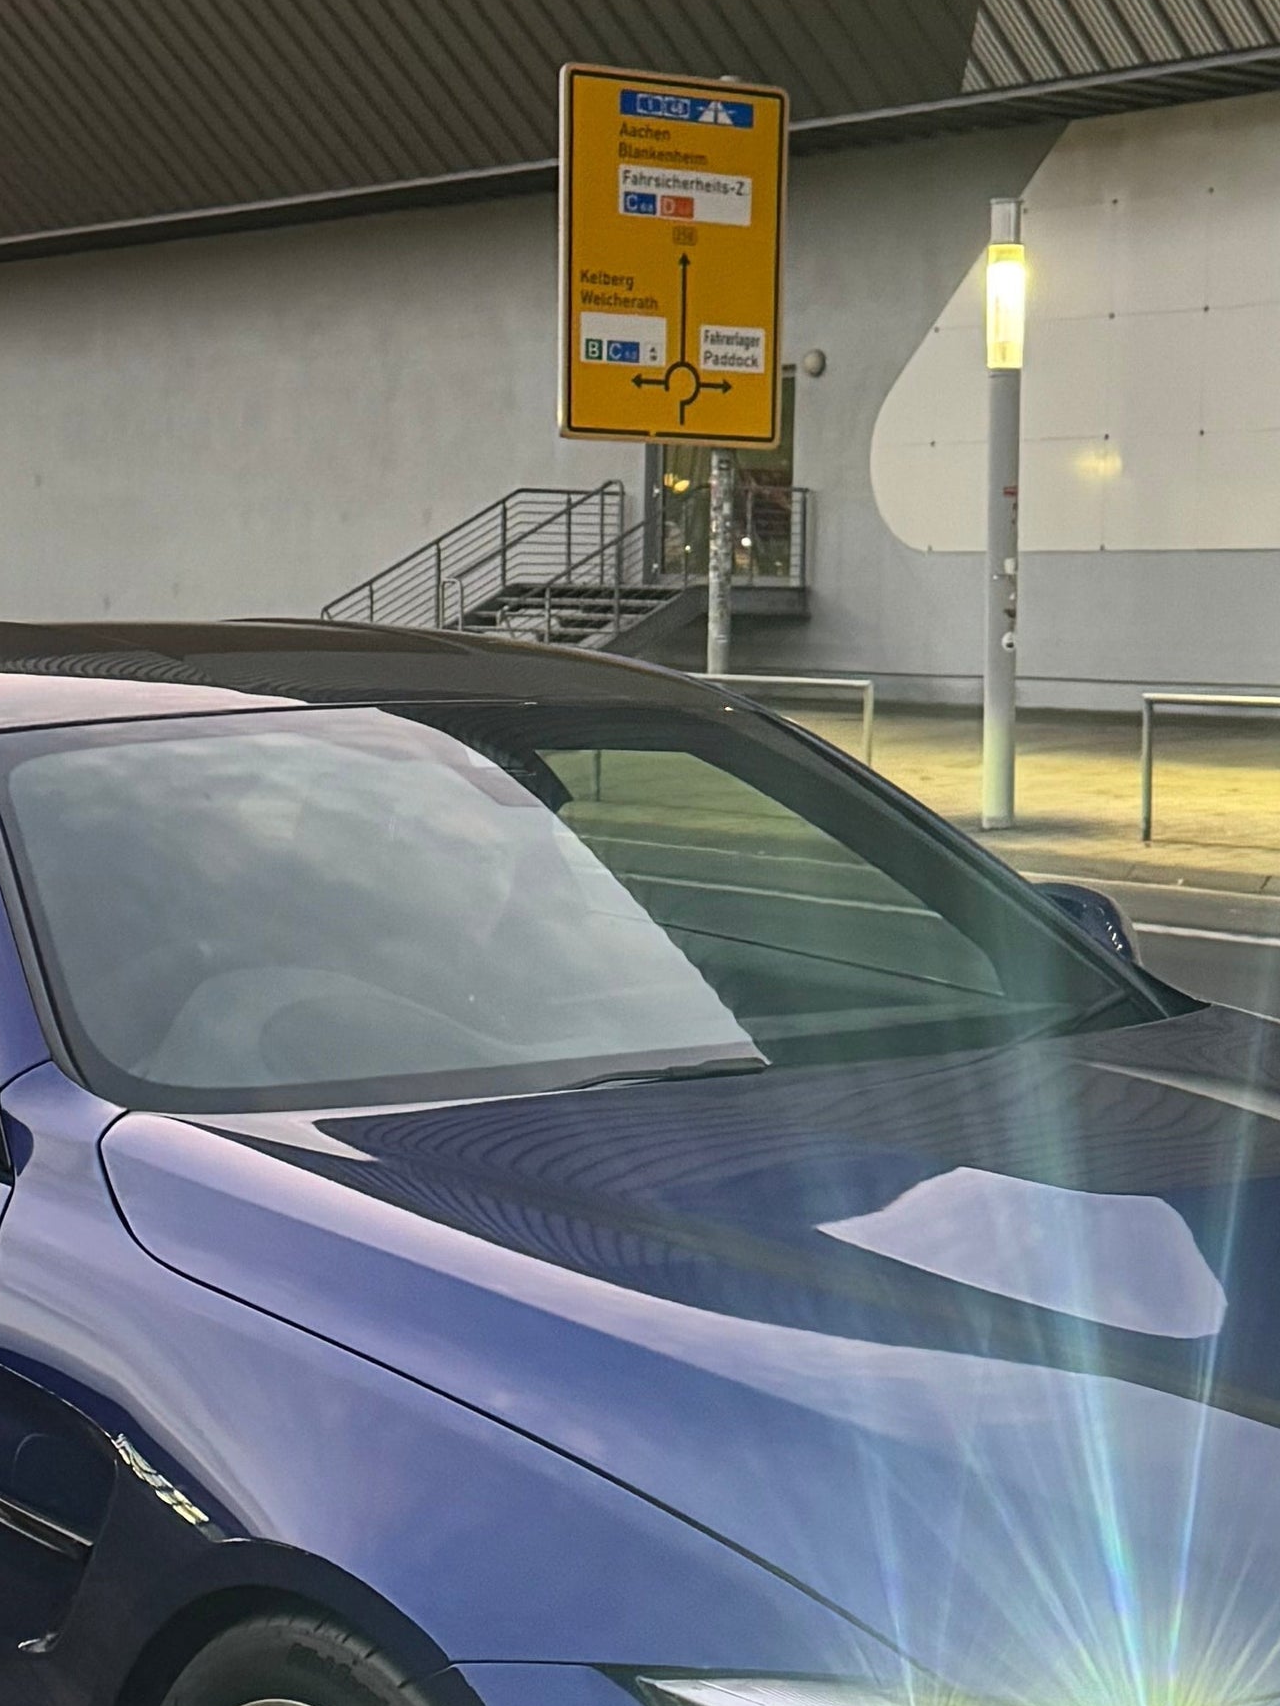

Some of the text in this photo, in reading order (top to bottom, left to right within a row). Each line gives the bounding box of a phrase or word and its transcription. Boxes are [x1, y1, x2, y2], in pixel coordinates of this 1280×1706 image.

[619, 122, 670, 141] Aachen
[618, 141, 708, 165] Blankenheim
[622, 169, 746, 197] Fahrsicherheits-Z
[580, 269, 635, 291] Kelberg
[580, 290, 659, 311] Welcherath
[588, 340, 600, 358] B
[703, 329, 761, 351] Fahrerlager
[703, 350, 759, 368] Paddock
